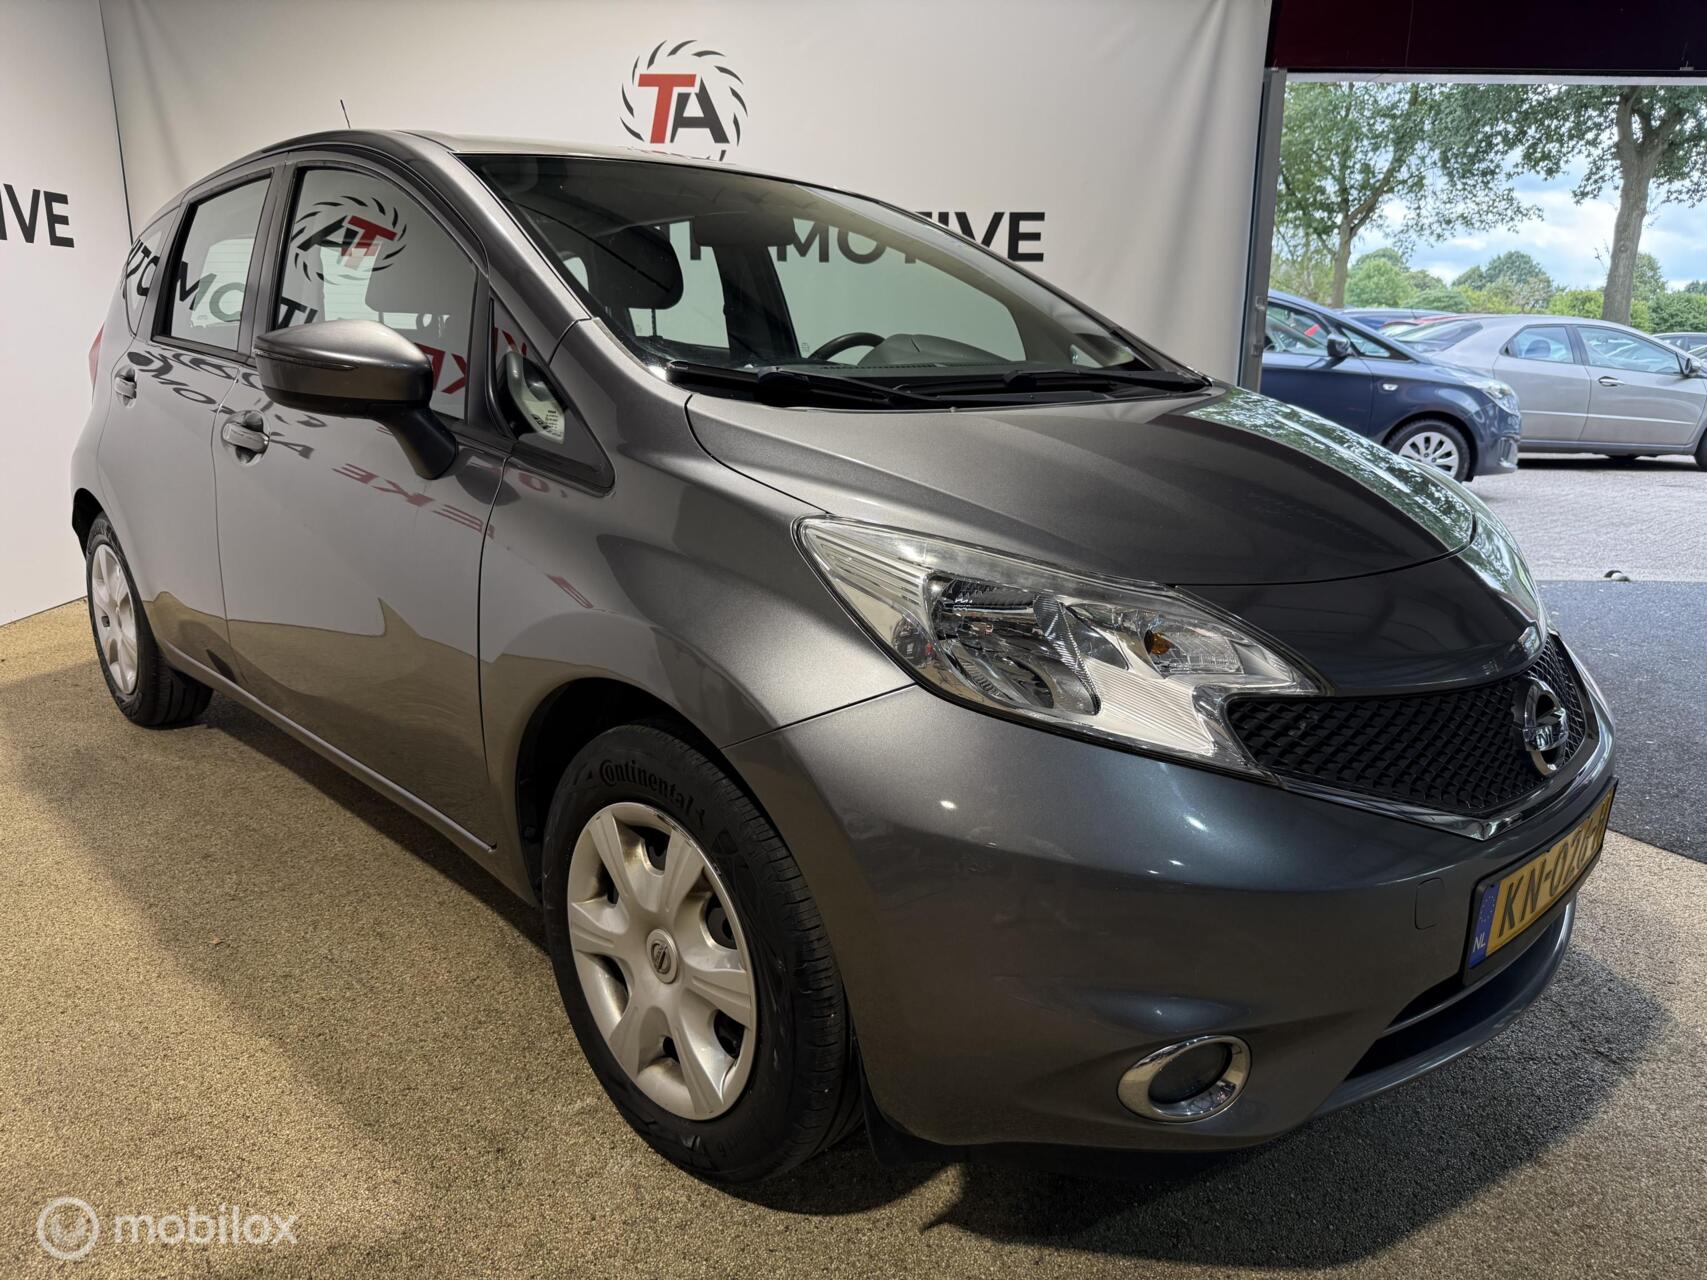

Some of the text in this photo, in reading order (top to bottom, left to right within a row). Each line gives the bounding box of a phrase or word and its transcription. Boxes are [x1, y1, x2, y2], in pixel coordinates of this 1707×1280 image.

[638, 74, 730, 144] TA
[600, 759, 694, 812] Continental
[1472, 931, 1487, 953] NL
